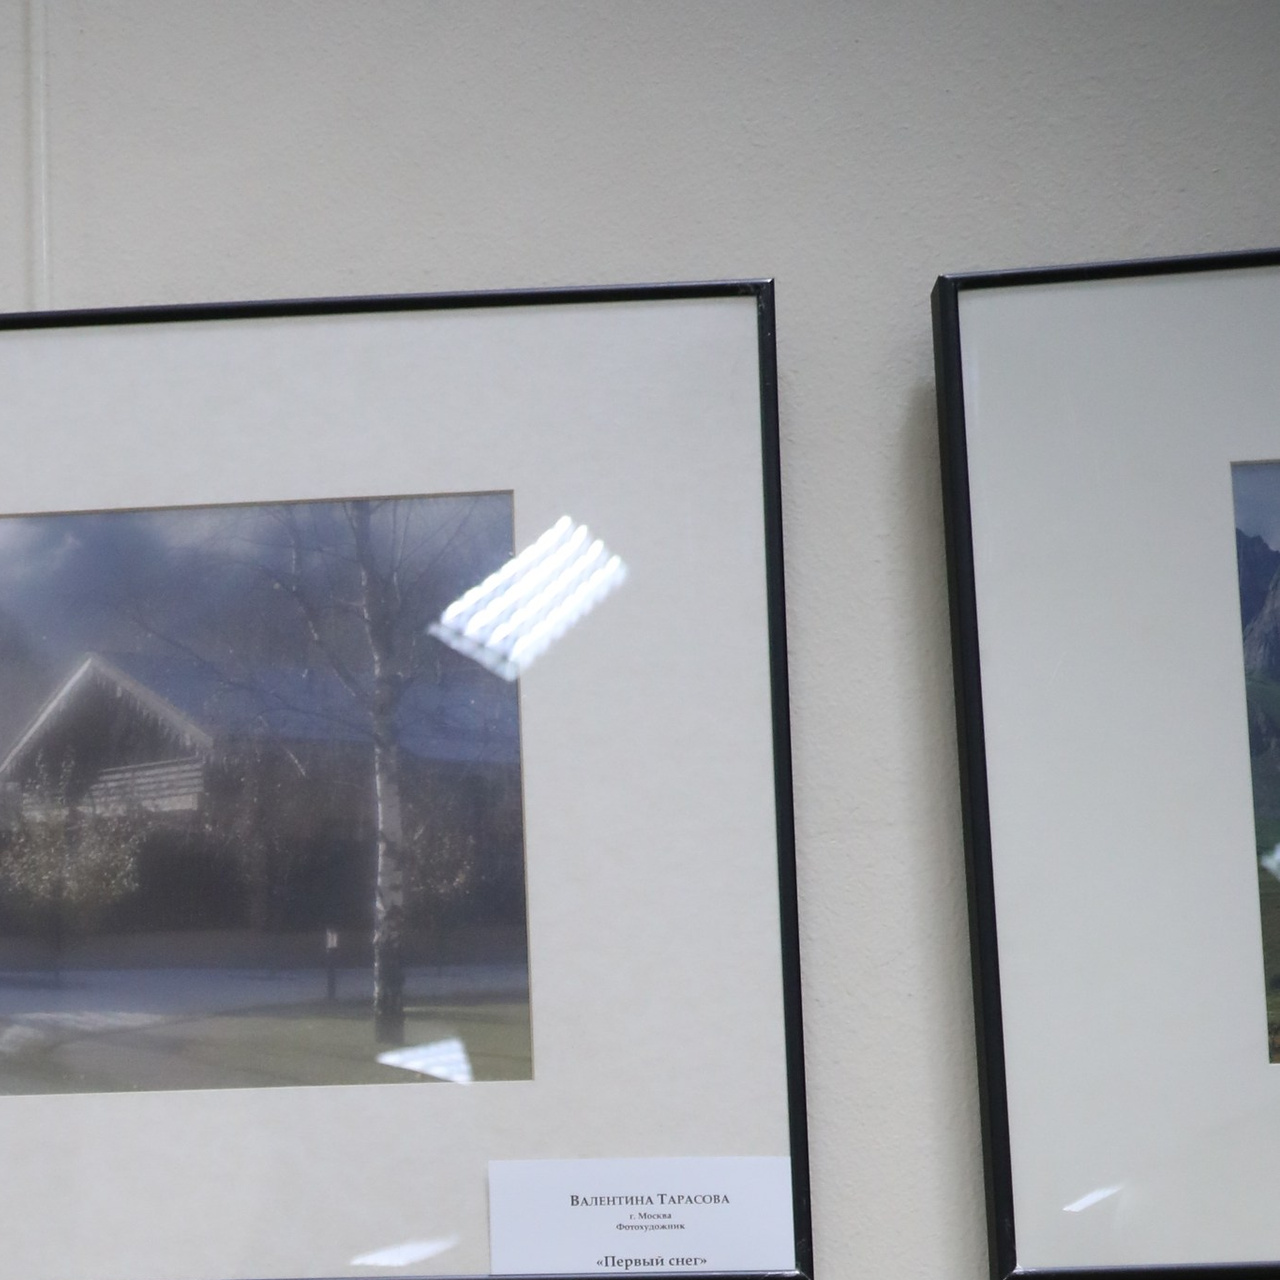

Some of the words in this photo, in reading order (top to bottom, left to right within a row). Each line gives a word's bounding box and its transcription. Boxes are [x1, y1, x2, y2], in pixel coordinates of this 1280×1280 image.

[638, 1212, 672, 1220] Москва
[616, 1223, 685, 1231] Фотохудожник
[596, 1255, 664, 1270] «Первый
[669, 1257, 707, 1267] снег»
